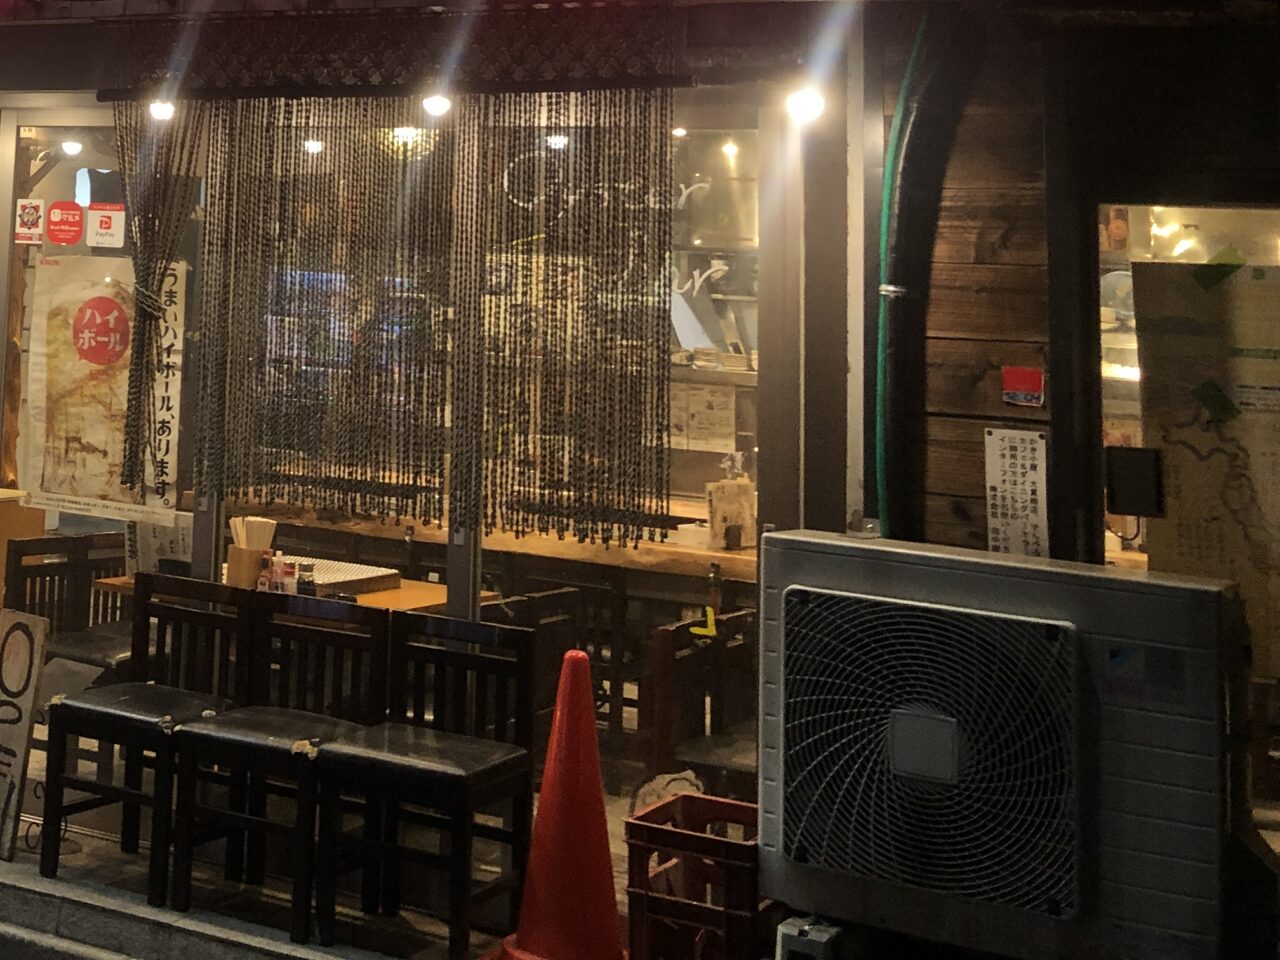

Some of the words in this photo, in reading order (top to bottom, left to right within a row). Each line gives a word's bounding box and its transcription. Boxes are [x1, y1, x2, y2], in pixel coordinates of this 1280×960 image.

[82, 308, 120, 327] ハイ
[77, 327, 124, 353] ボール
